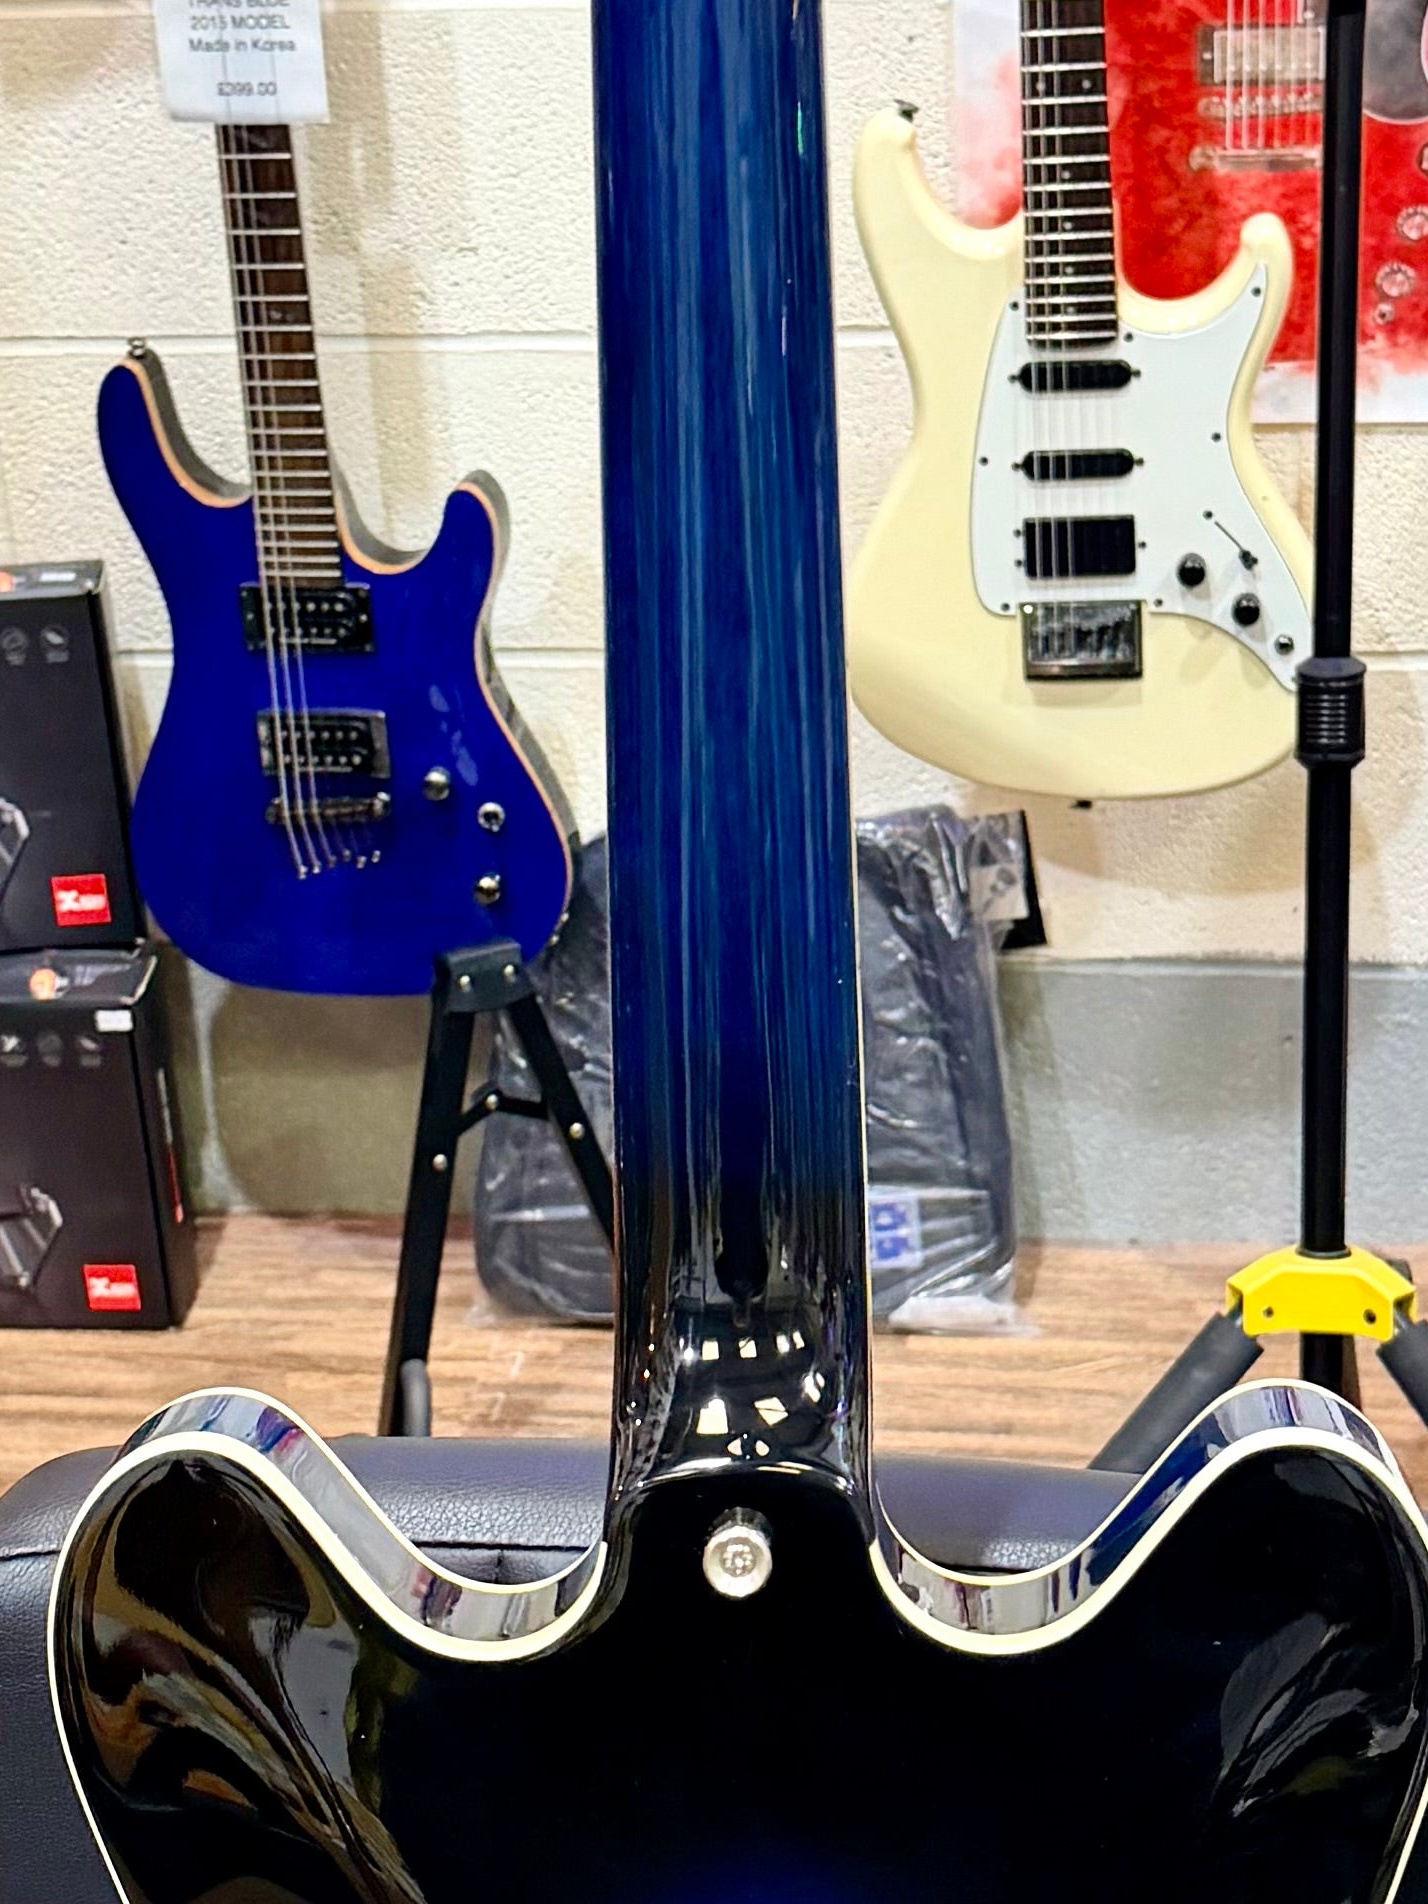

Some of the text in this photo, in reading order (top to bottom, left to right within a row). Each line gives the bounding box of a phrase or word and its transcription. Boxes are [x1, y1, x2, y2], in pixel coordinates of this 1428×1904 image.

[232, 15, 290, 30] MODEL
[189, 38, 296, 52] Made in Korea
